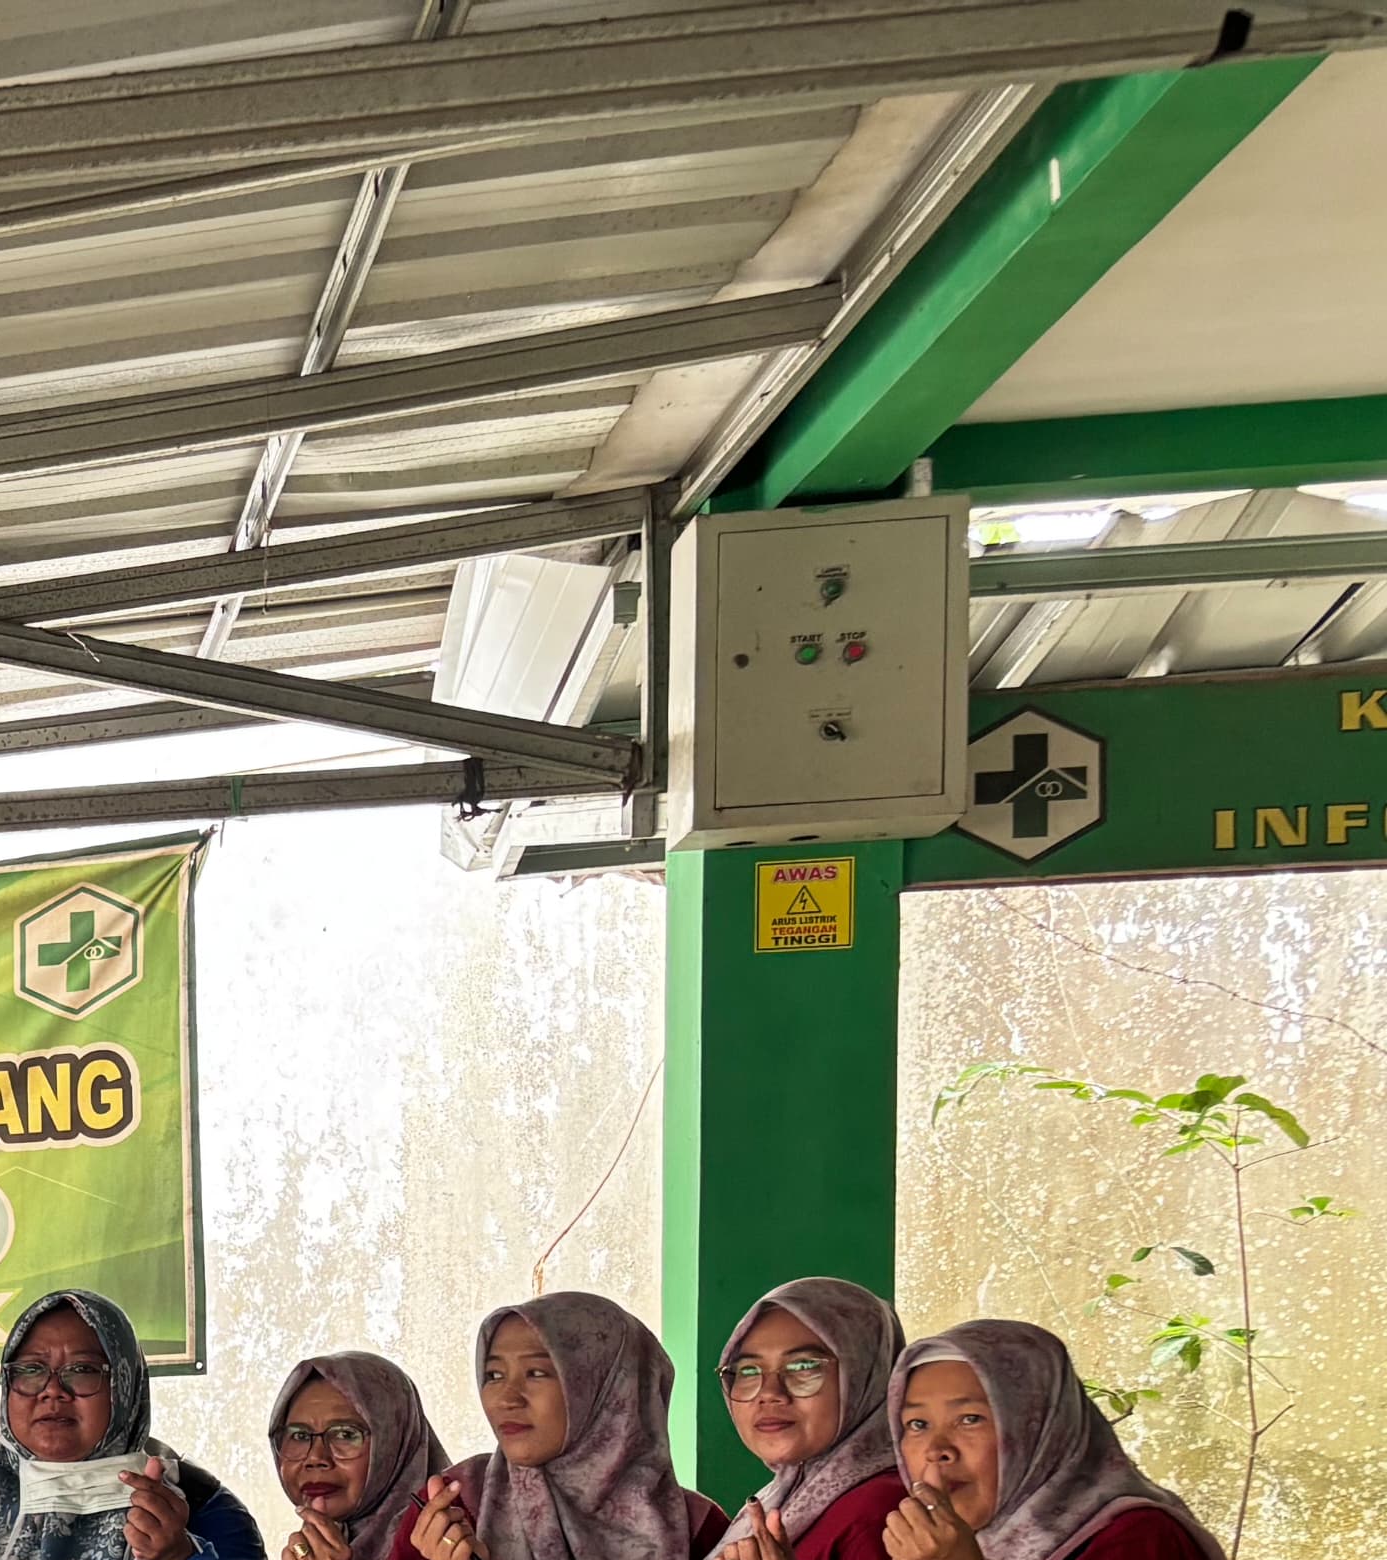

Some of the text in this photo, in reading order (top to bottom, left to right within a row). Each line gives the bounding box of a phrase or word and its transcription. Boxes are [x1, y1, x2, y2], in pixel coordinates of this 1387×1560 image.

[789, 633, 823, 644] START
[838, 631, 867, 642] STOP
[1214, 803, 1387, 849] INF
[773, 865, 838, 882] AWAS
[771, 914, 838, 926] ARUS LISTRIK
[770, 924, 837, 936] TEGANGAN
[770, 934, 837, 946] TINGGI
